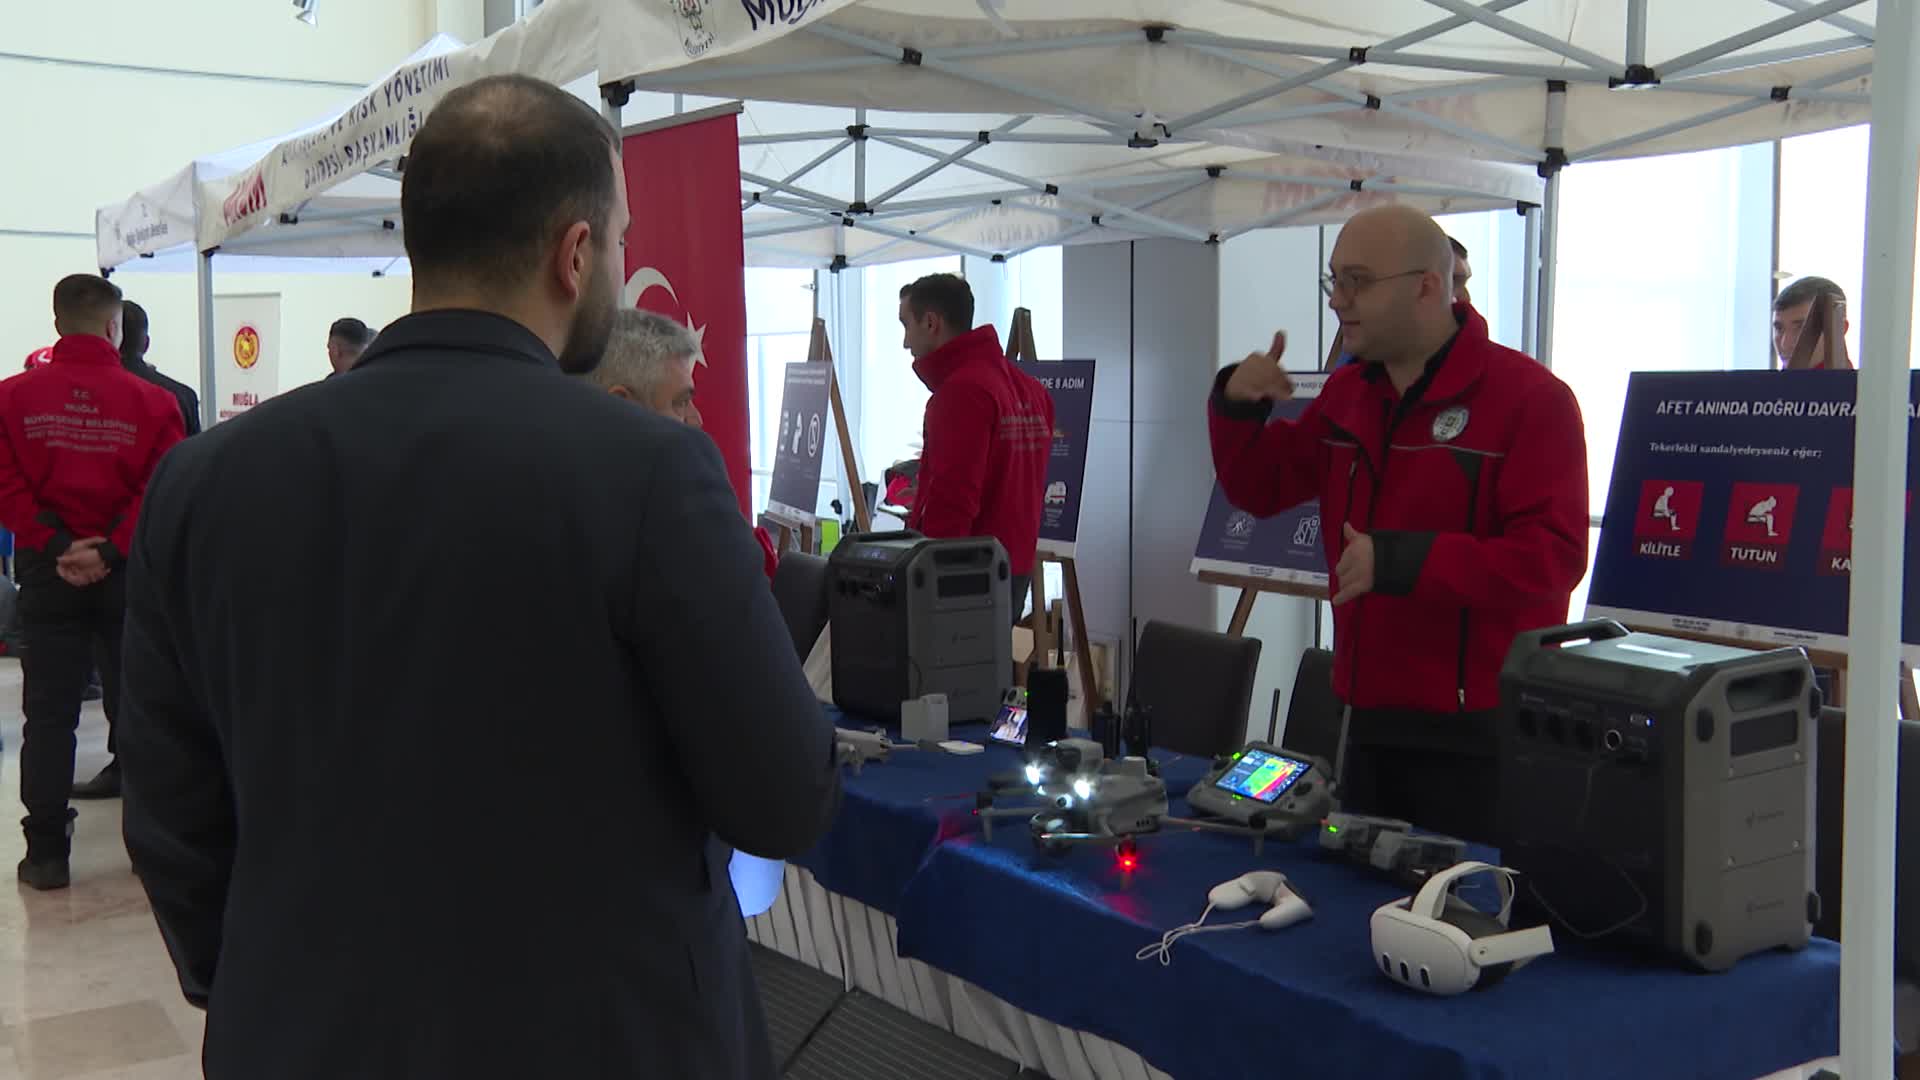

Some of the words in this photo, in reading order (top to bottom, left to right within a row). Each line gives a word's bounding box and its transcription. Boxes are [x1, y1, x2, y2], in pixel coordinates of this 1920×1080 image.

[1062, 377, 1085, 389] ADIM
[1656, 401, 1691, 415] AFET
[1695, 401, 1749, 416] ANINDA
[1752, 398, 1804, 417] DOĞRU
[1649, 441, 1698, 454] Tekerlekli
[1699, 444, 1791, 458] sandalyedeyseniz
[1639, 542, 1681, 557] KİLİTLE
[1730, 547, 1777, 563] TUTUN
